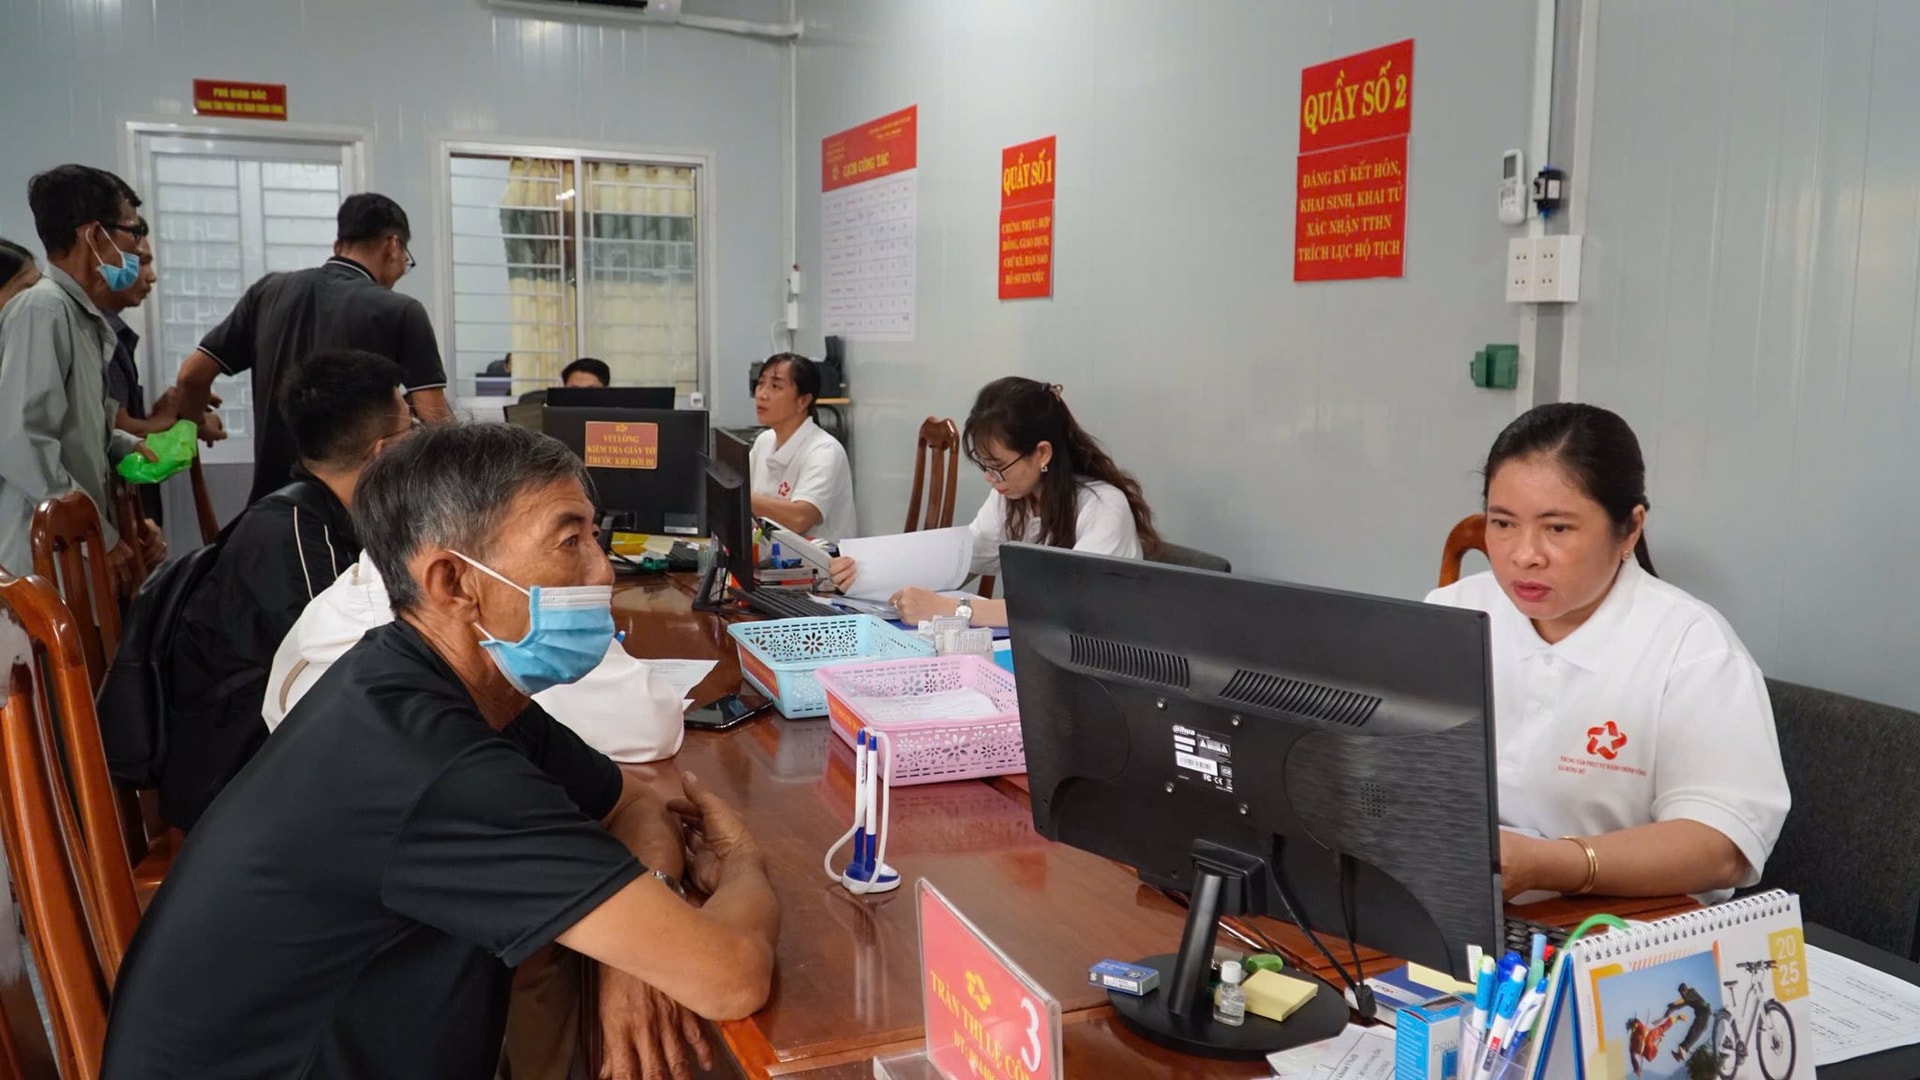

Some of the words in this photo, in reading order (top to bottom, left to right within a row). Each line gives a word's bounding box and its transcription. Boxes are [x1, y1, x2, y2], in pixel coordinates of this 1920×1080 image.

[1304, 69, 1359, 135] QUẦY
[1362, 60, 1391, 116] SỐ
[1394, 74, 1407, 109] 2
[1003, 152, 1030, 197] QUẦY
[1031, 148, 1045, 186] SỐ
[1046, 159, 1052, 182] 1
[1303, 170, 1331, 189] ĐĂNG
[1334, 165, 1347, 184] KÝ
[1350, 160, 1372, 181] KẾT
[1374, 158, 1401, 178] HÔN,
[1300, 197, 1325, 213] KHAI
[1327, 193, 1355, 210] SINH,
[1357, 189, 1385, 206] KHAI
[1387, 181, 1404, 202] TỬ
[1307, 218, 1327, 237] XÁC
[1329, 214, 1359, 237] NHẬN
[1361, 214, 1392, 232] TTHN
[1299, 243, 1328, 262] TRÍCH
[1332, 244, 1352, 262] LỤC
[1355, 238, 1371, 261] HỘ
[1373, 239, 1400, 260] TỊCH
[587, 445, 607, 454] KIỂM
[608, 445, 623, 454] TRA
[624, 445, 642, 455] GIẤY
[603, 433, 617, 443] VUI
[617, 432, 639, 443] LÒNG
[589, 455, 613, 465] TRƯỚC
[615, 457, 630, 465] KHI
[1776, 934, 1797, 960] 20
[1780, 962, 1800, 987] 25
[930, 970, 959, 1018] TRẦN
[1021, 997, 1041, 1072] 3
